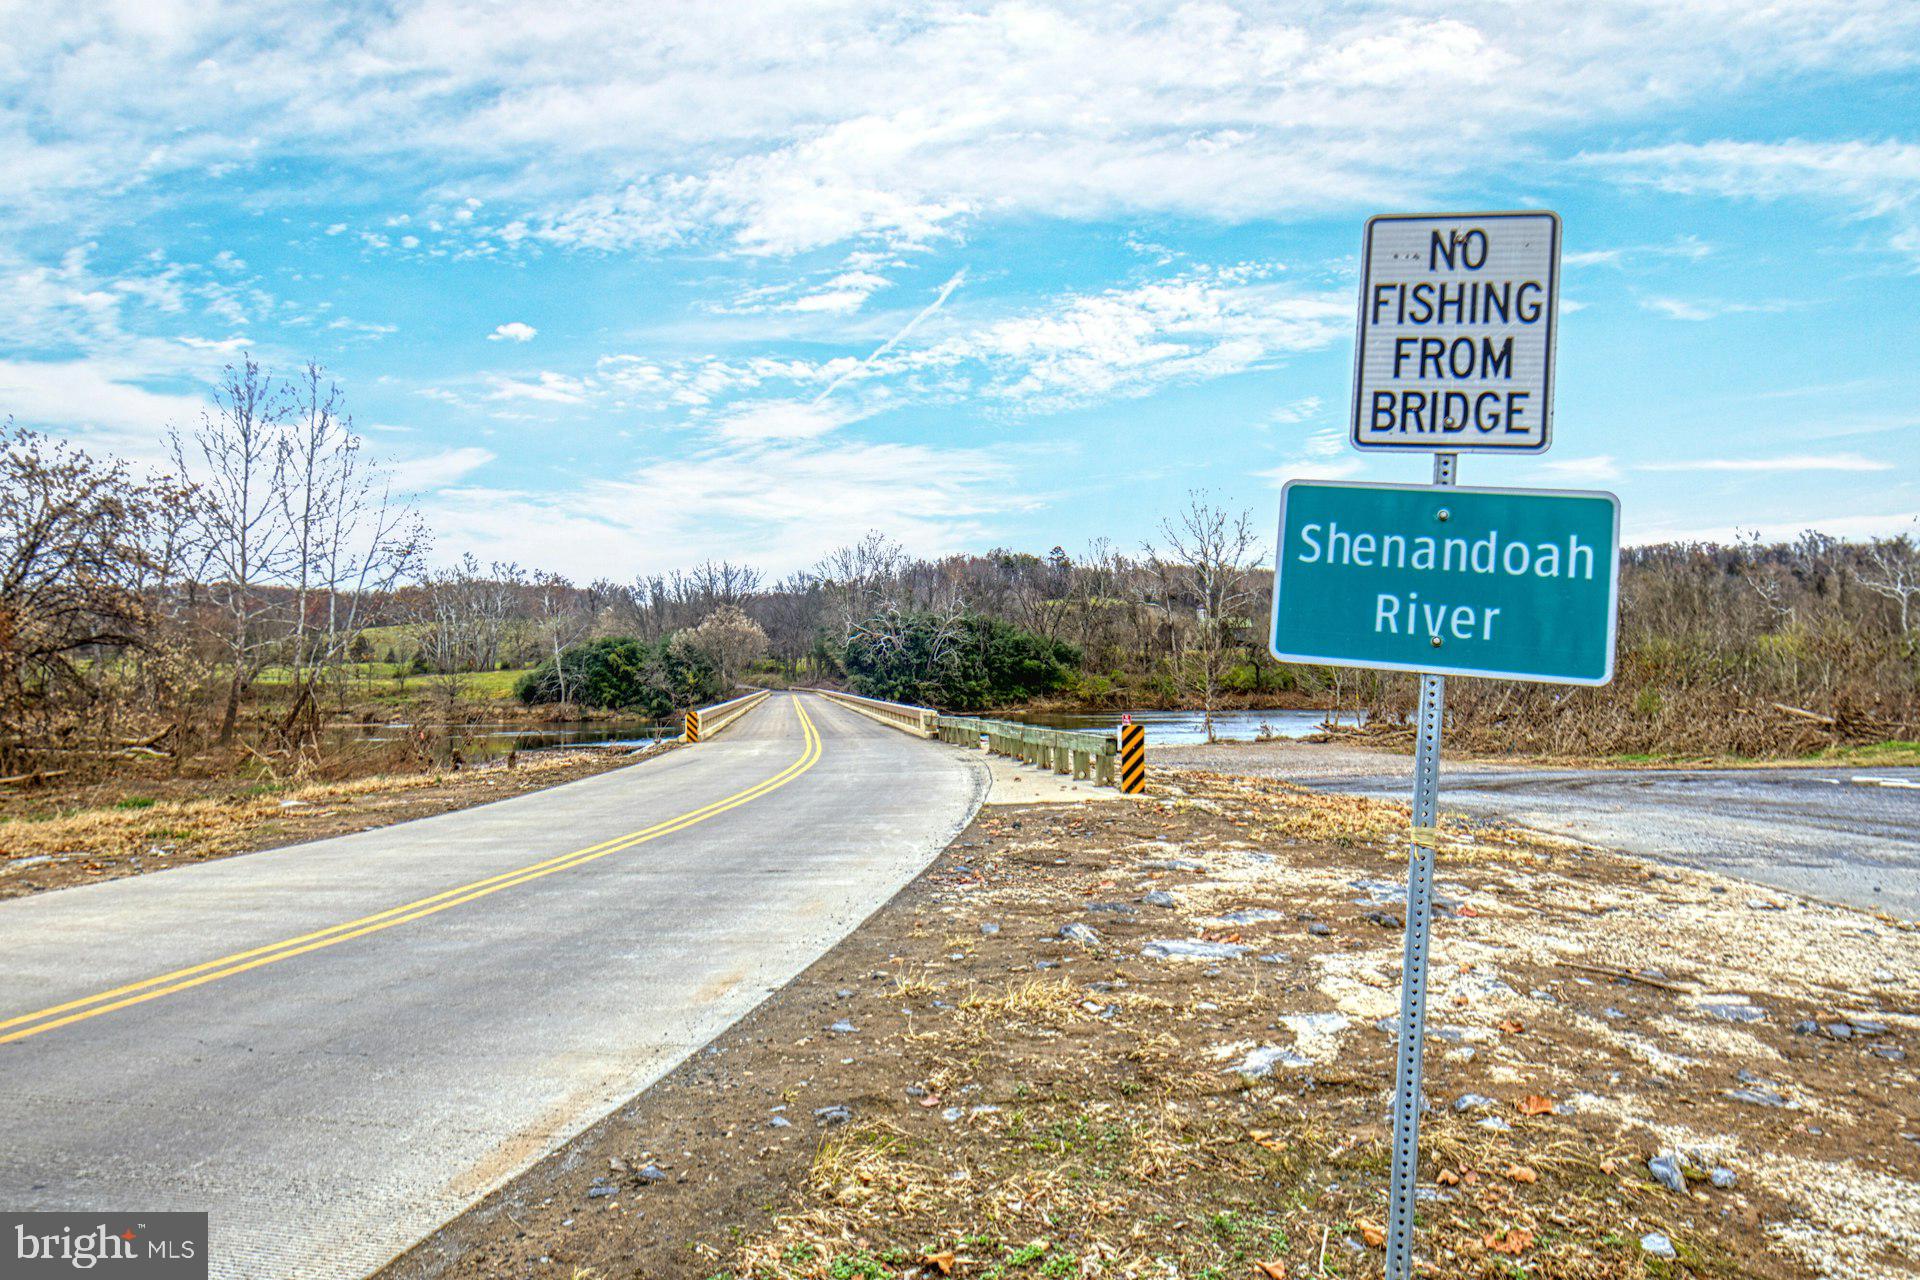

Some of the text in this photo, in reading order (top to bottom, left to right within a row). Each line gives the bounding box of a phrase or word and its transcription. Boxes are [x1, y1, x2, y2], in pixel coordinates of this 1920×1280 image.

[1429, 227, 1489, 271] NO
[1372, 281, 1543, 326] FISHING
[1392, 336, 1514, 380] FROM
[1370, 390, 1531, 435] BRIDGE
[1298, 522, 1595, 580] Shenandoah
[1374, 592, 1501, 641] River
